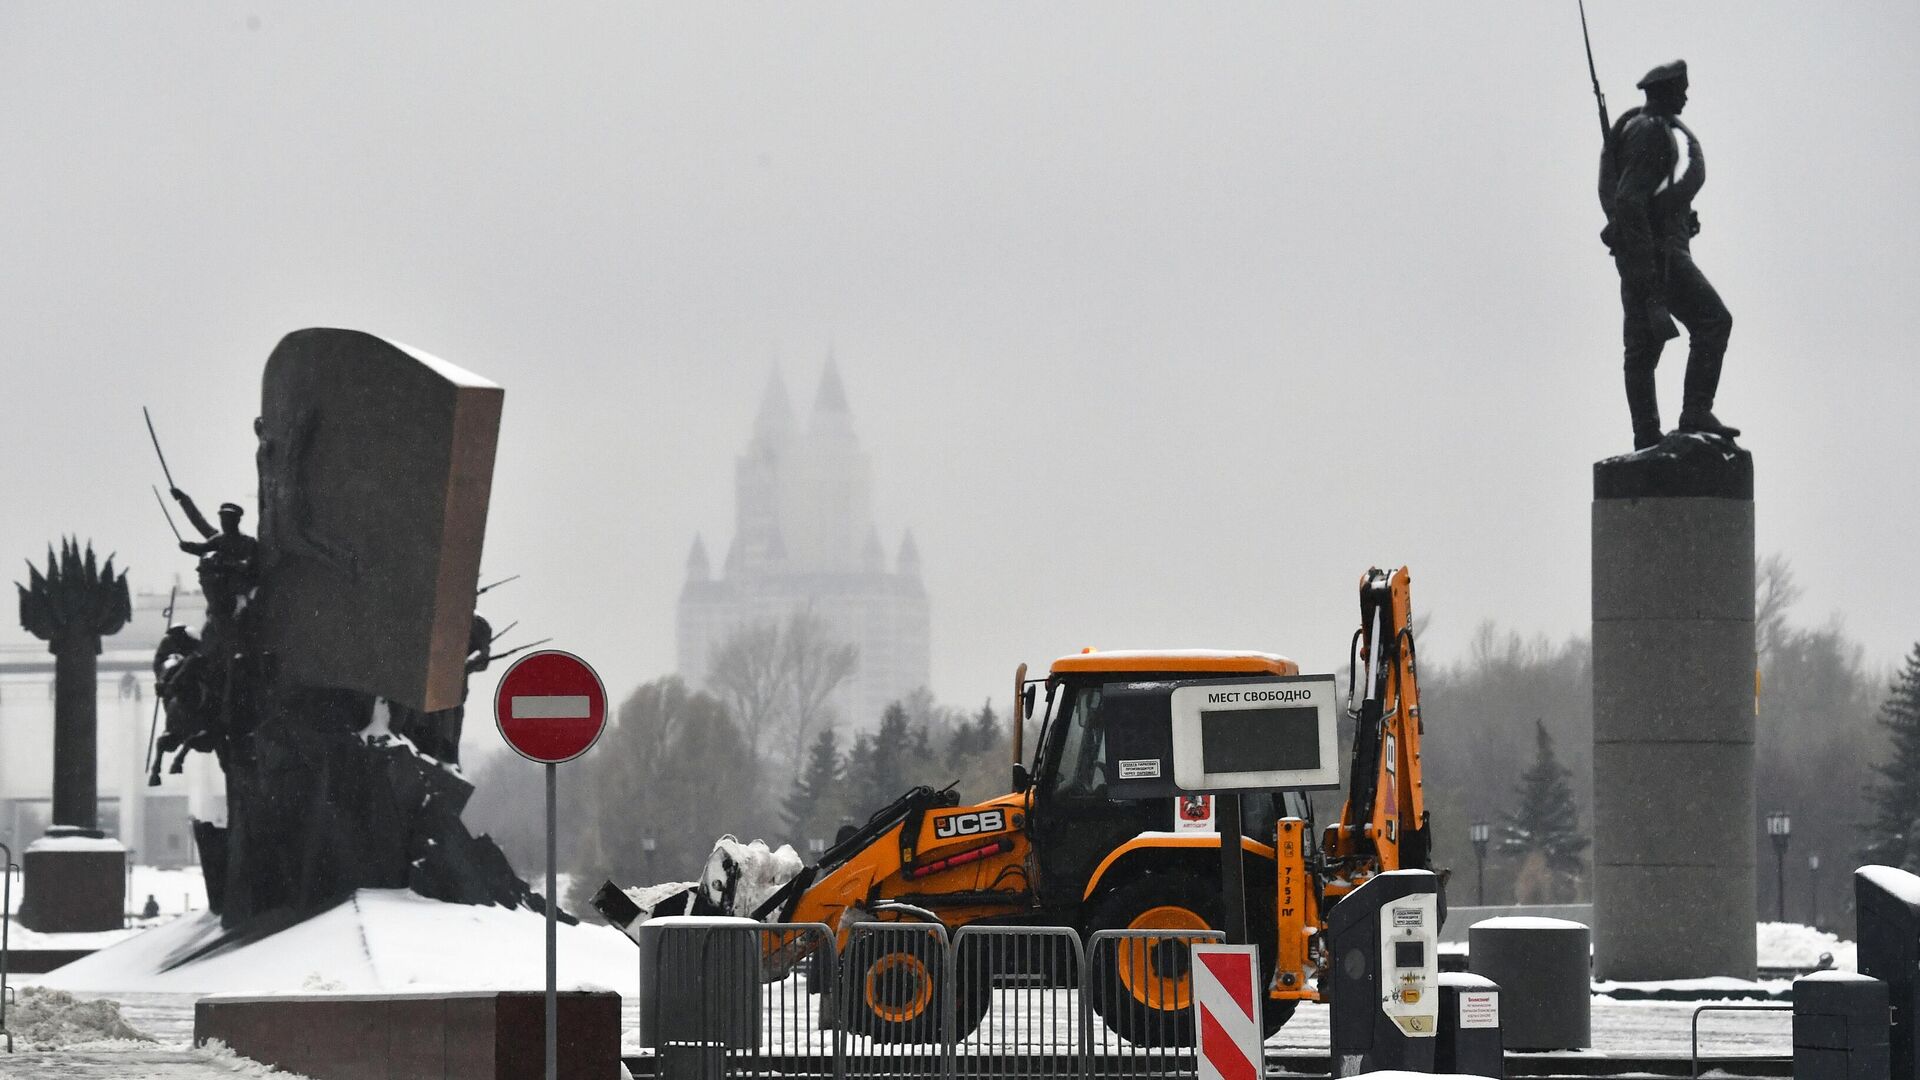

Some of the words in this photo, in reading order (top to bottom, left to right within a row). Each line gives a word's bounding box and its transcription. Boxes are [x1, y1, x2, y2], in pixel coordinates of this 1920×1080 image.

[1208, 692, 1241, 703] МЕСТ
[1243, 689, 1312, 702] СВОБОДНО
[937, 811, 1003, 837] JCB
